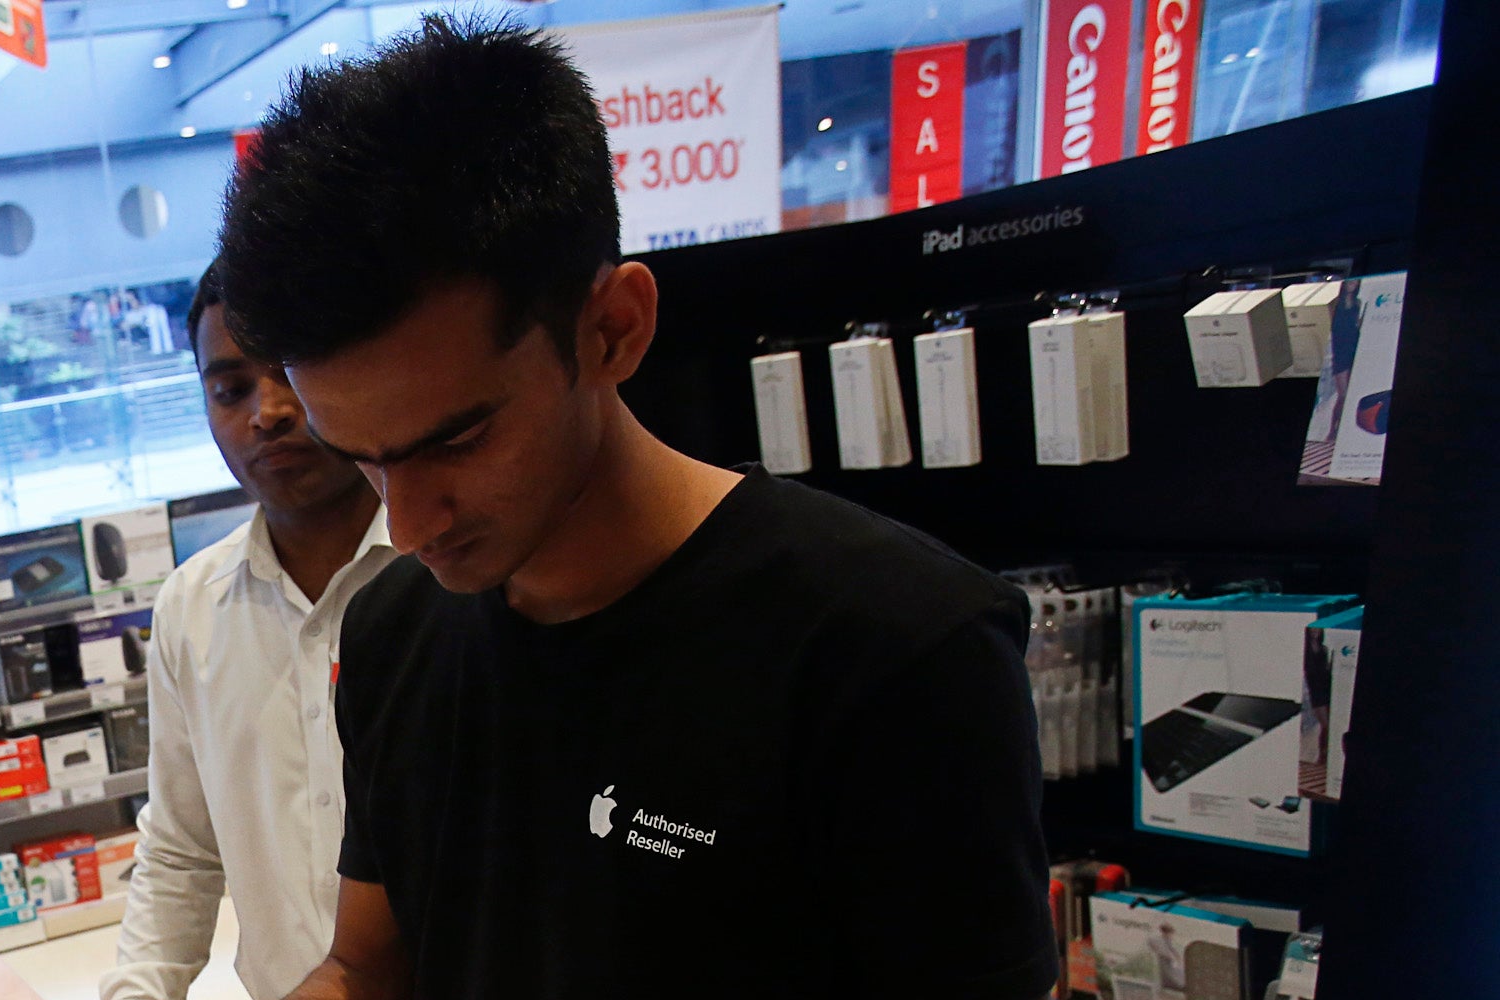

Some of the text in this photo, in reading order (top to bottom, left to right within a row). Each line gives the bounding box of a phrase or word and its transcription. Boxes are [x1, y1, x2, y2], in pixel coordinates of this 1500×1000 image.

[1146, 0, 1190, 154] Cano
[597, 76, 726, 129] shback
[922, 205, 1085, 255] iPad accessories
[1168, 619, 1223, 633] Logitech
[626, 829, 686, 860] Reseller
[632, 808, 717, 846] Authorised
